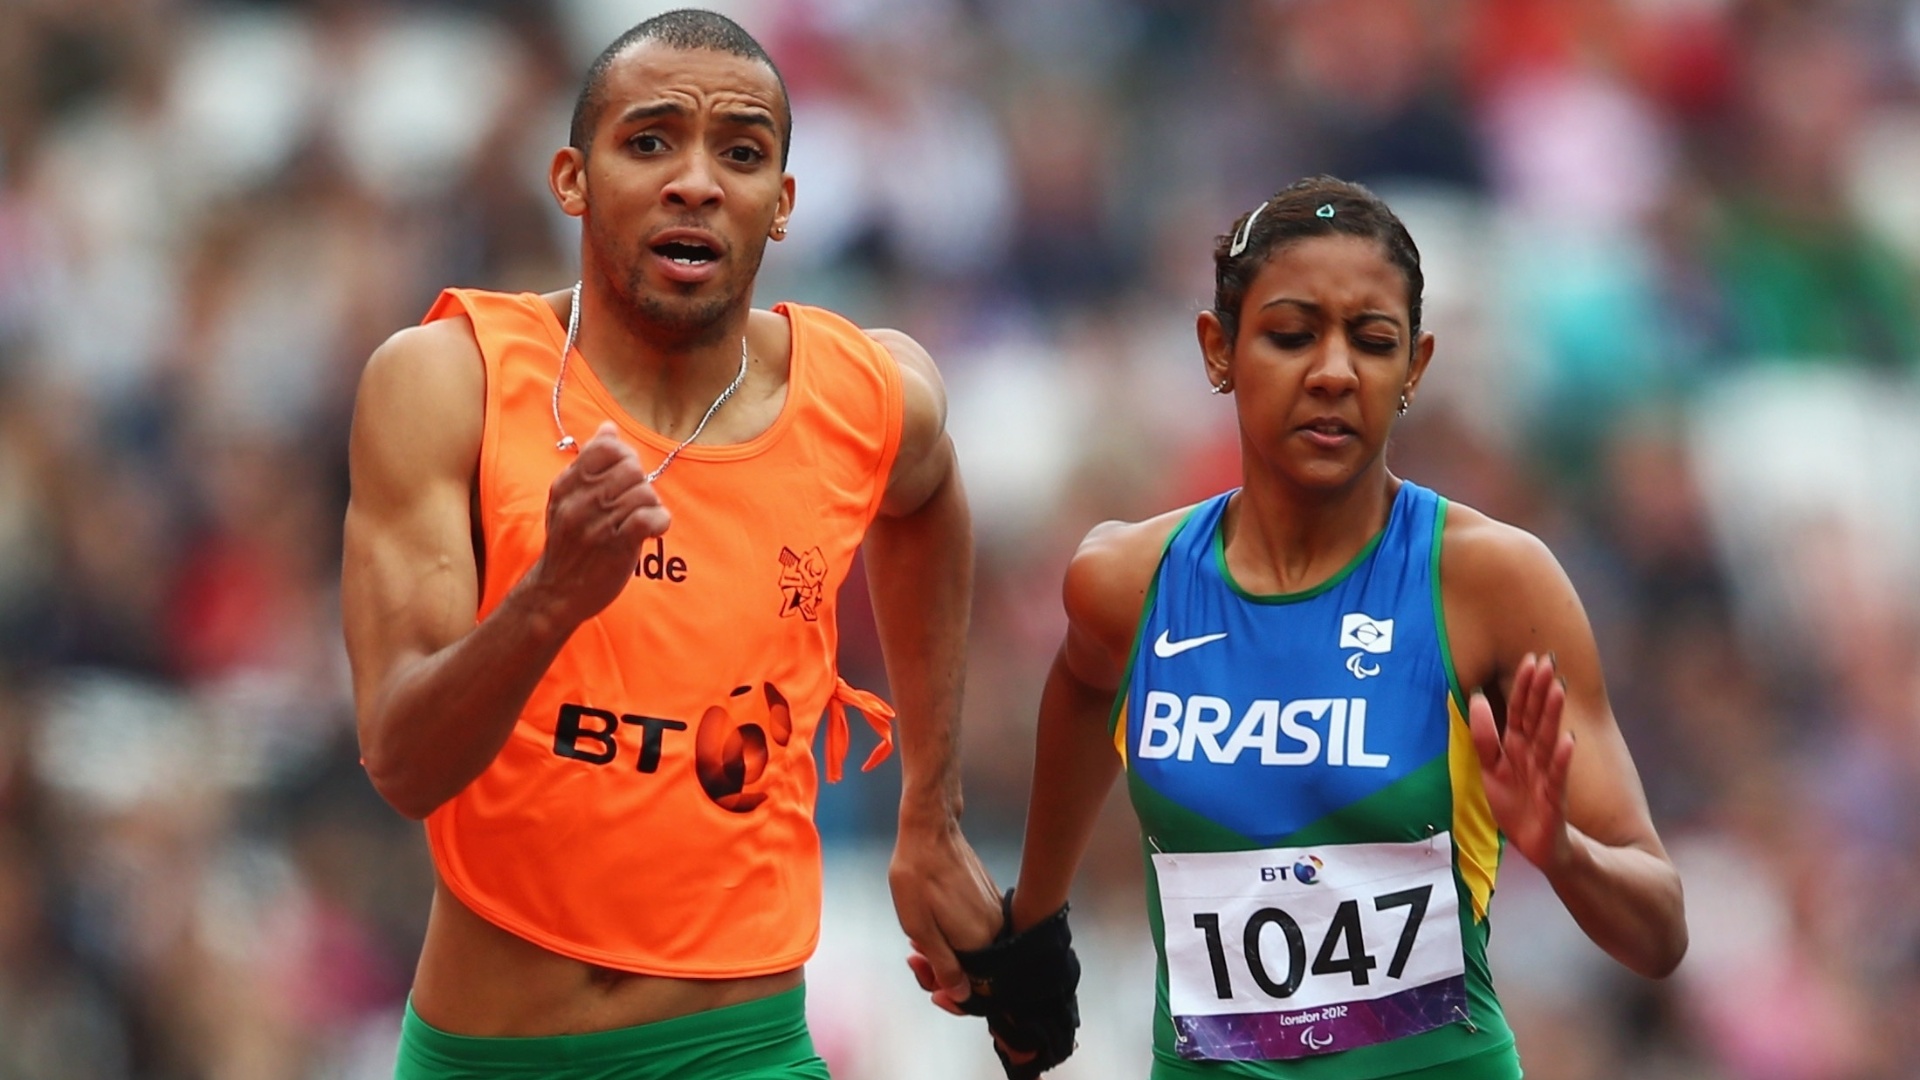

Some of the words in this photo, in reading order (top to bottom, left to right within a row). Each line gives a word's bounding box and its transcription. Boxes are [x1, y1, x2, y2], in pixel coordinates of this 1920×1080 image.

[553, 703, 687, 774] BT
[1138, 690, 1391, 768] BRASIL
[1260, 866, 1291, 882] BT
[1193, 884, 1433, 1000] 1047
[1280, 1011, 1320, 1026] London
[1321, 1005, 1348, 1020] 2012
